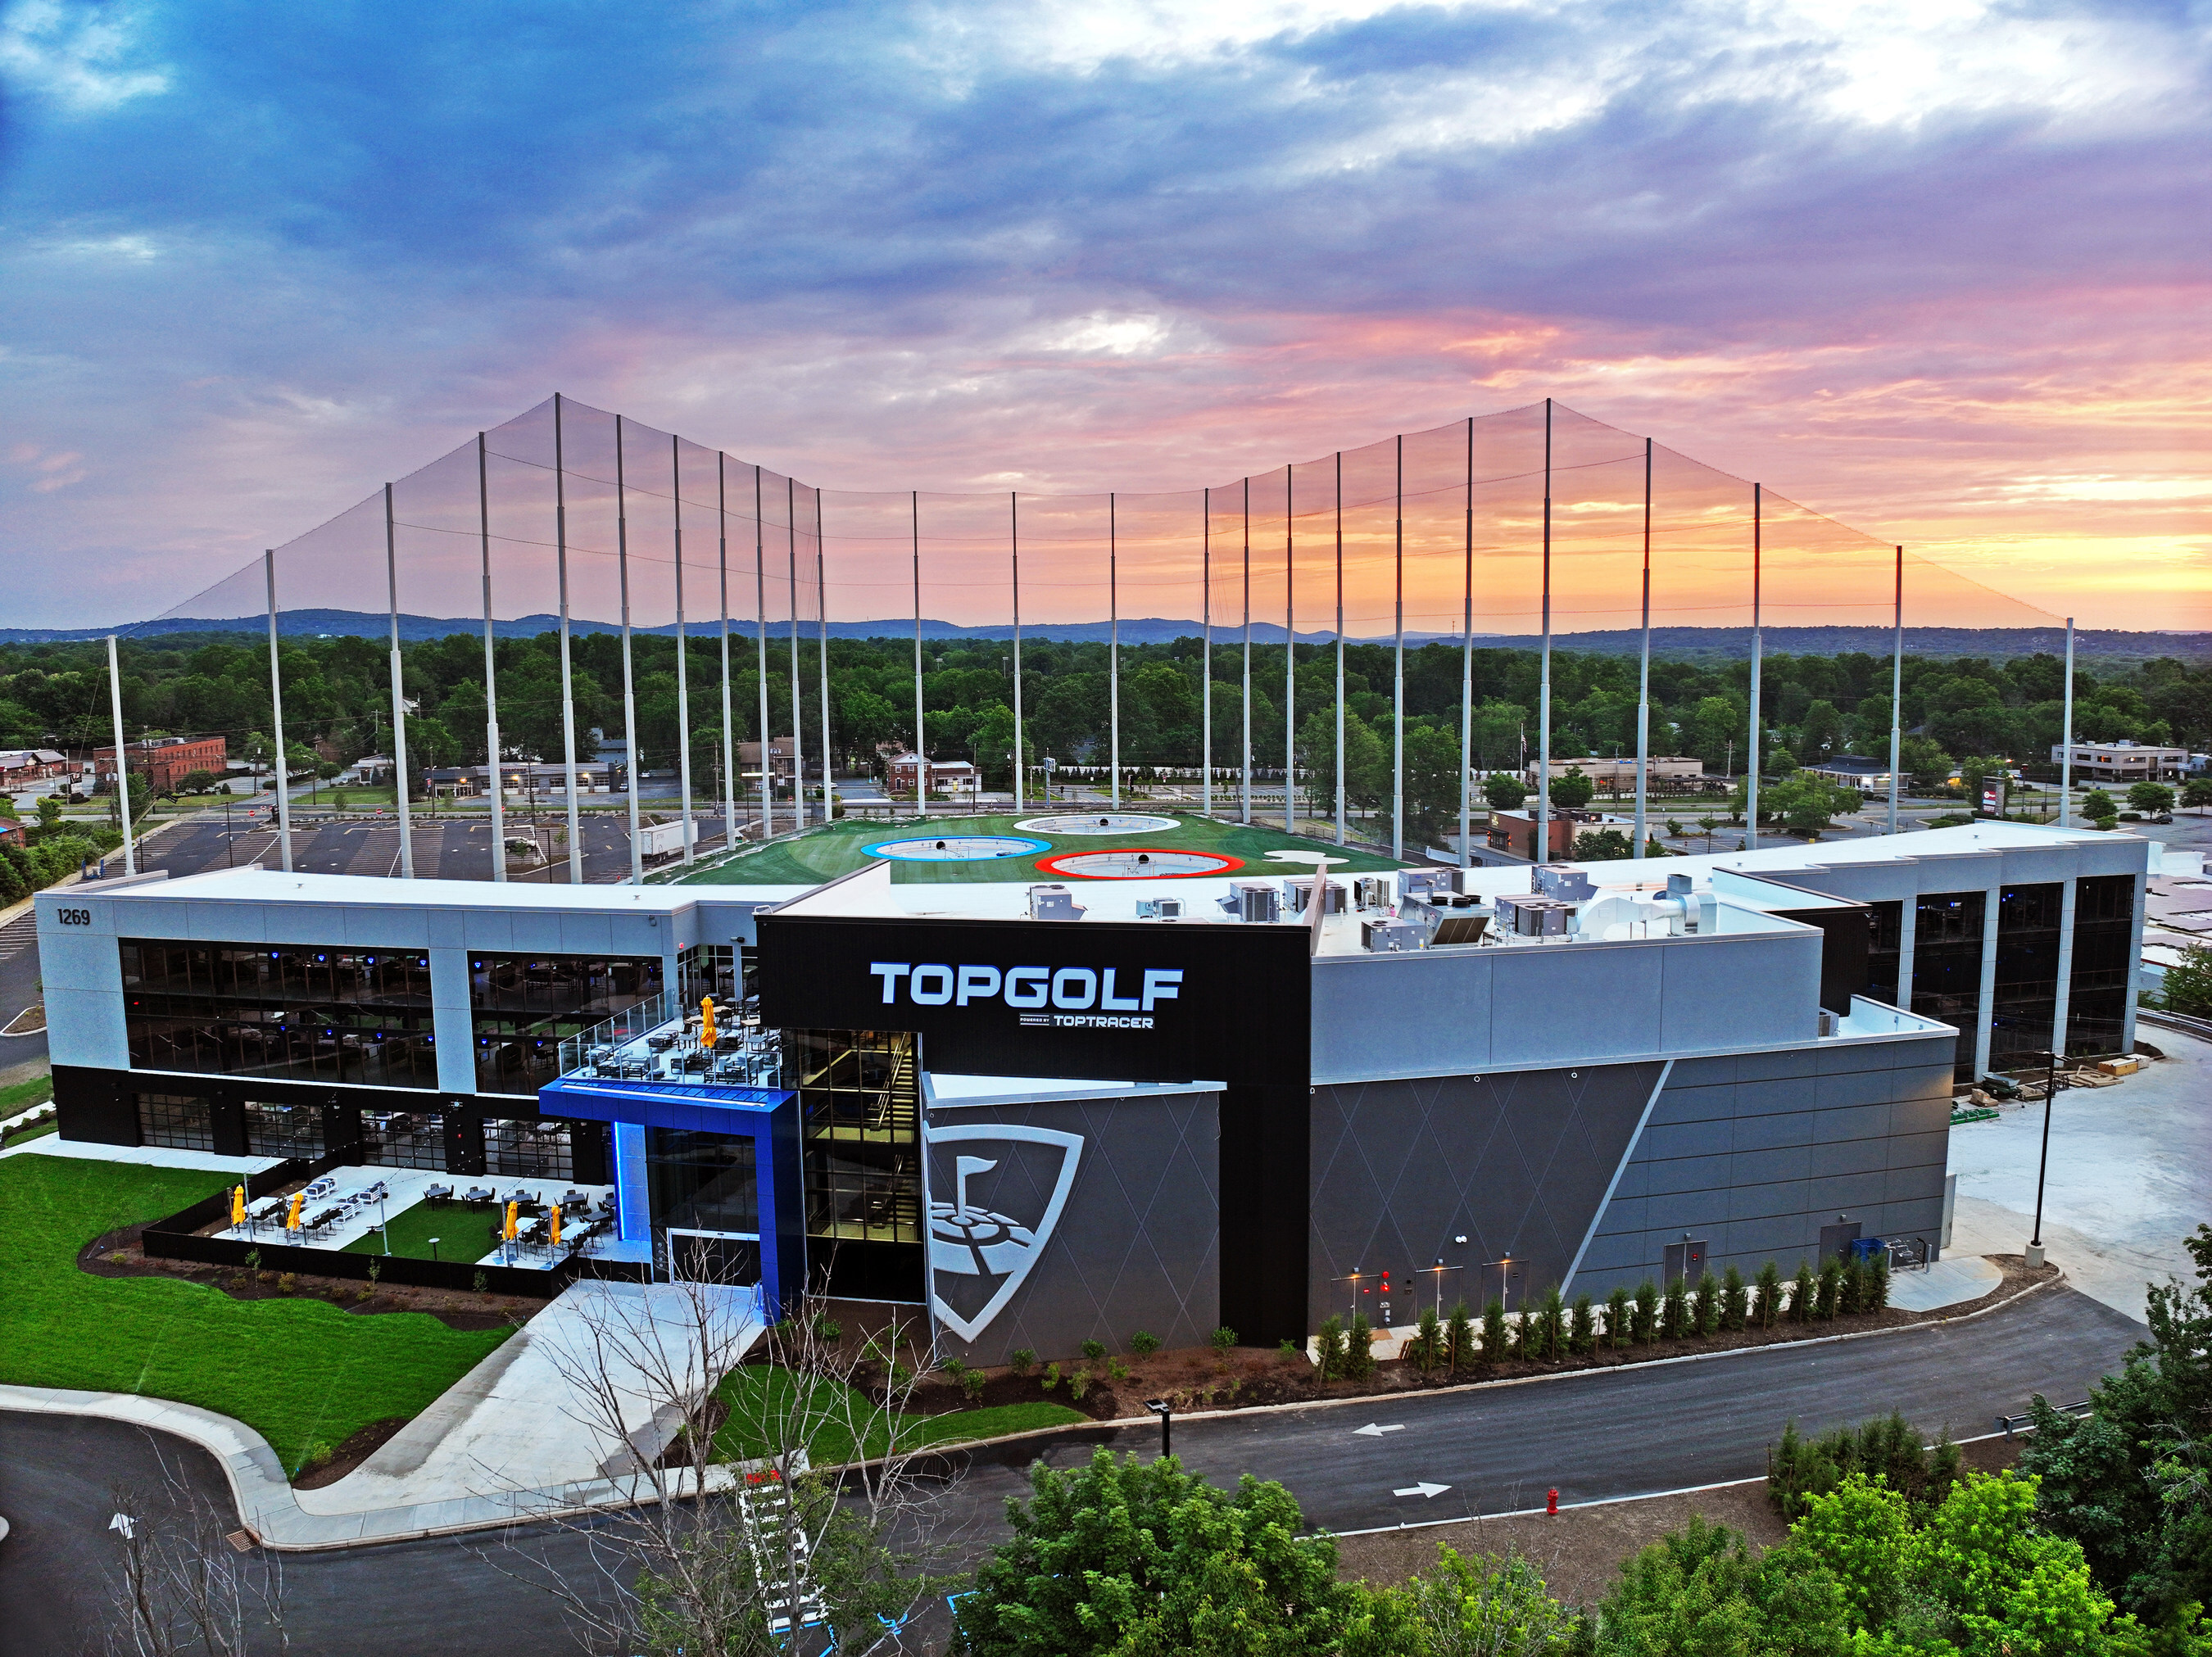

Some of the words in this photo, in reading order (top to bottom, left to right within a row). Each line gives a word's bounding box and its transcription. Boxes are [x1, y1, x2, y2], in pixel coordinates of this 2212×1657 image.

[57, 908, 90, 926] 1269
[870, 962, 1184, 1011] TOPGOLF
[1054, 1015, 1154, 1029] TOPTRACER
